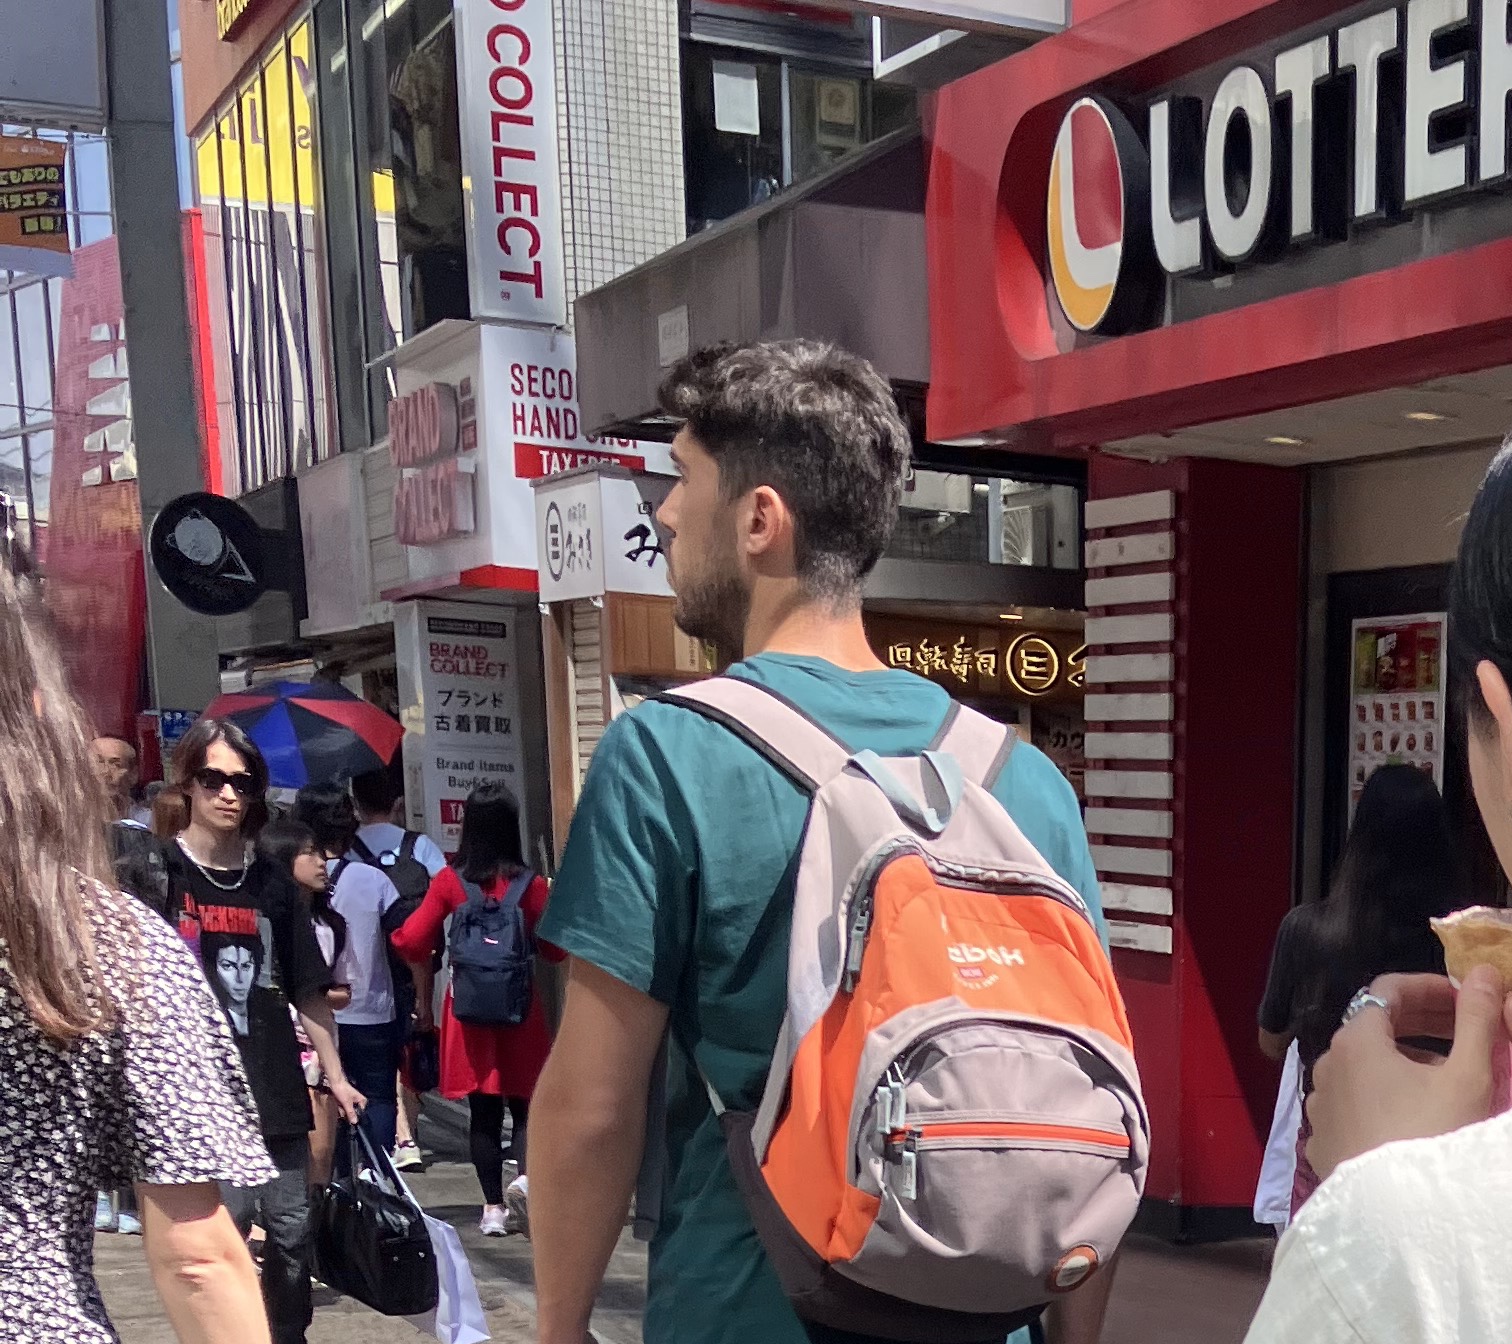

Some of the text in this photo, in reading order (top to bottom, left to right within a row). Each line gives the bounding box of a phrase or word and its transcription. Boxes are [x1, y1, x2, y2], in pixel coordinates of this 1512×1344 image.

[486, 23, 544, 299] COLLECT
[512, 402, 578, 441] HAND
[539, 449, 572, 475] TAX
[429, 642, 489, 662] BRAND
[430, 659, 511, 679] COLLECT
[437, 690, 505, 709] ブランド
[434, 714, 512, 735] 古着買取
[436, 757, 475, 772] Brand
